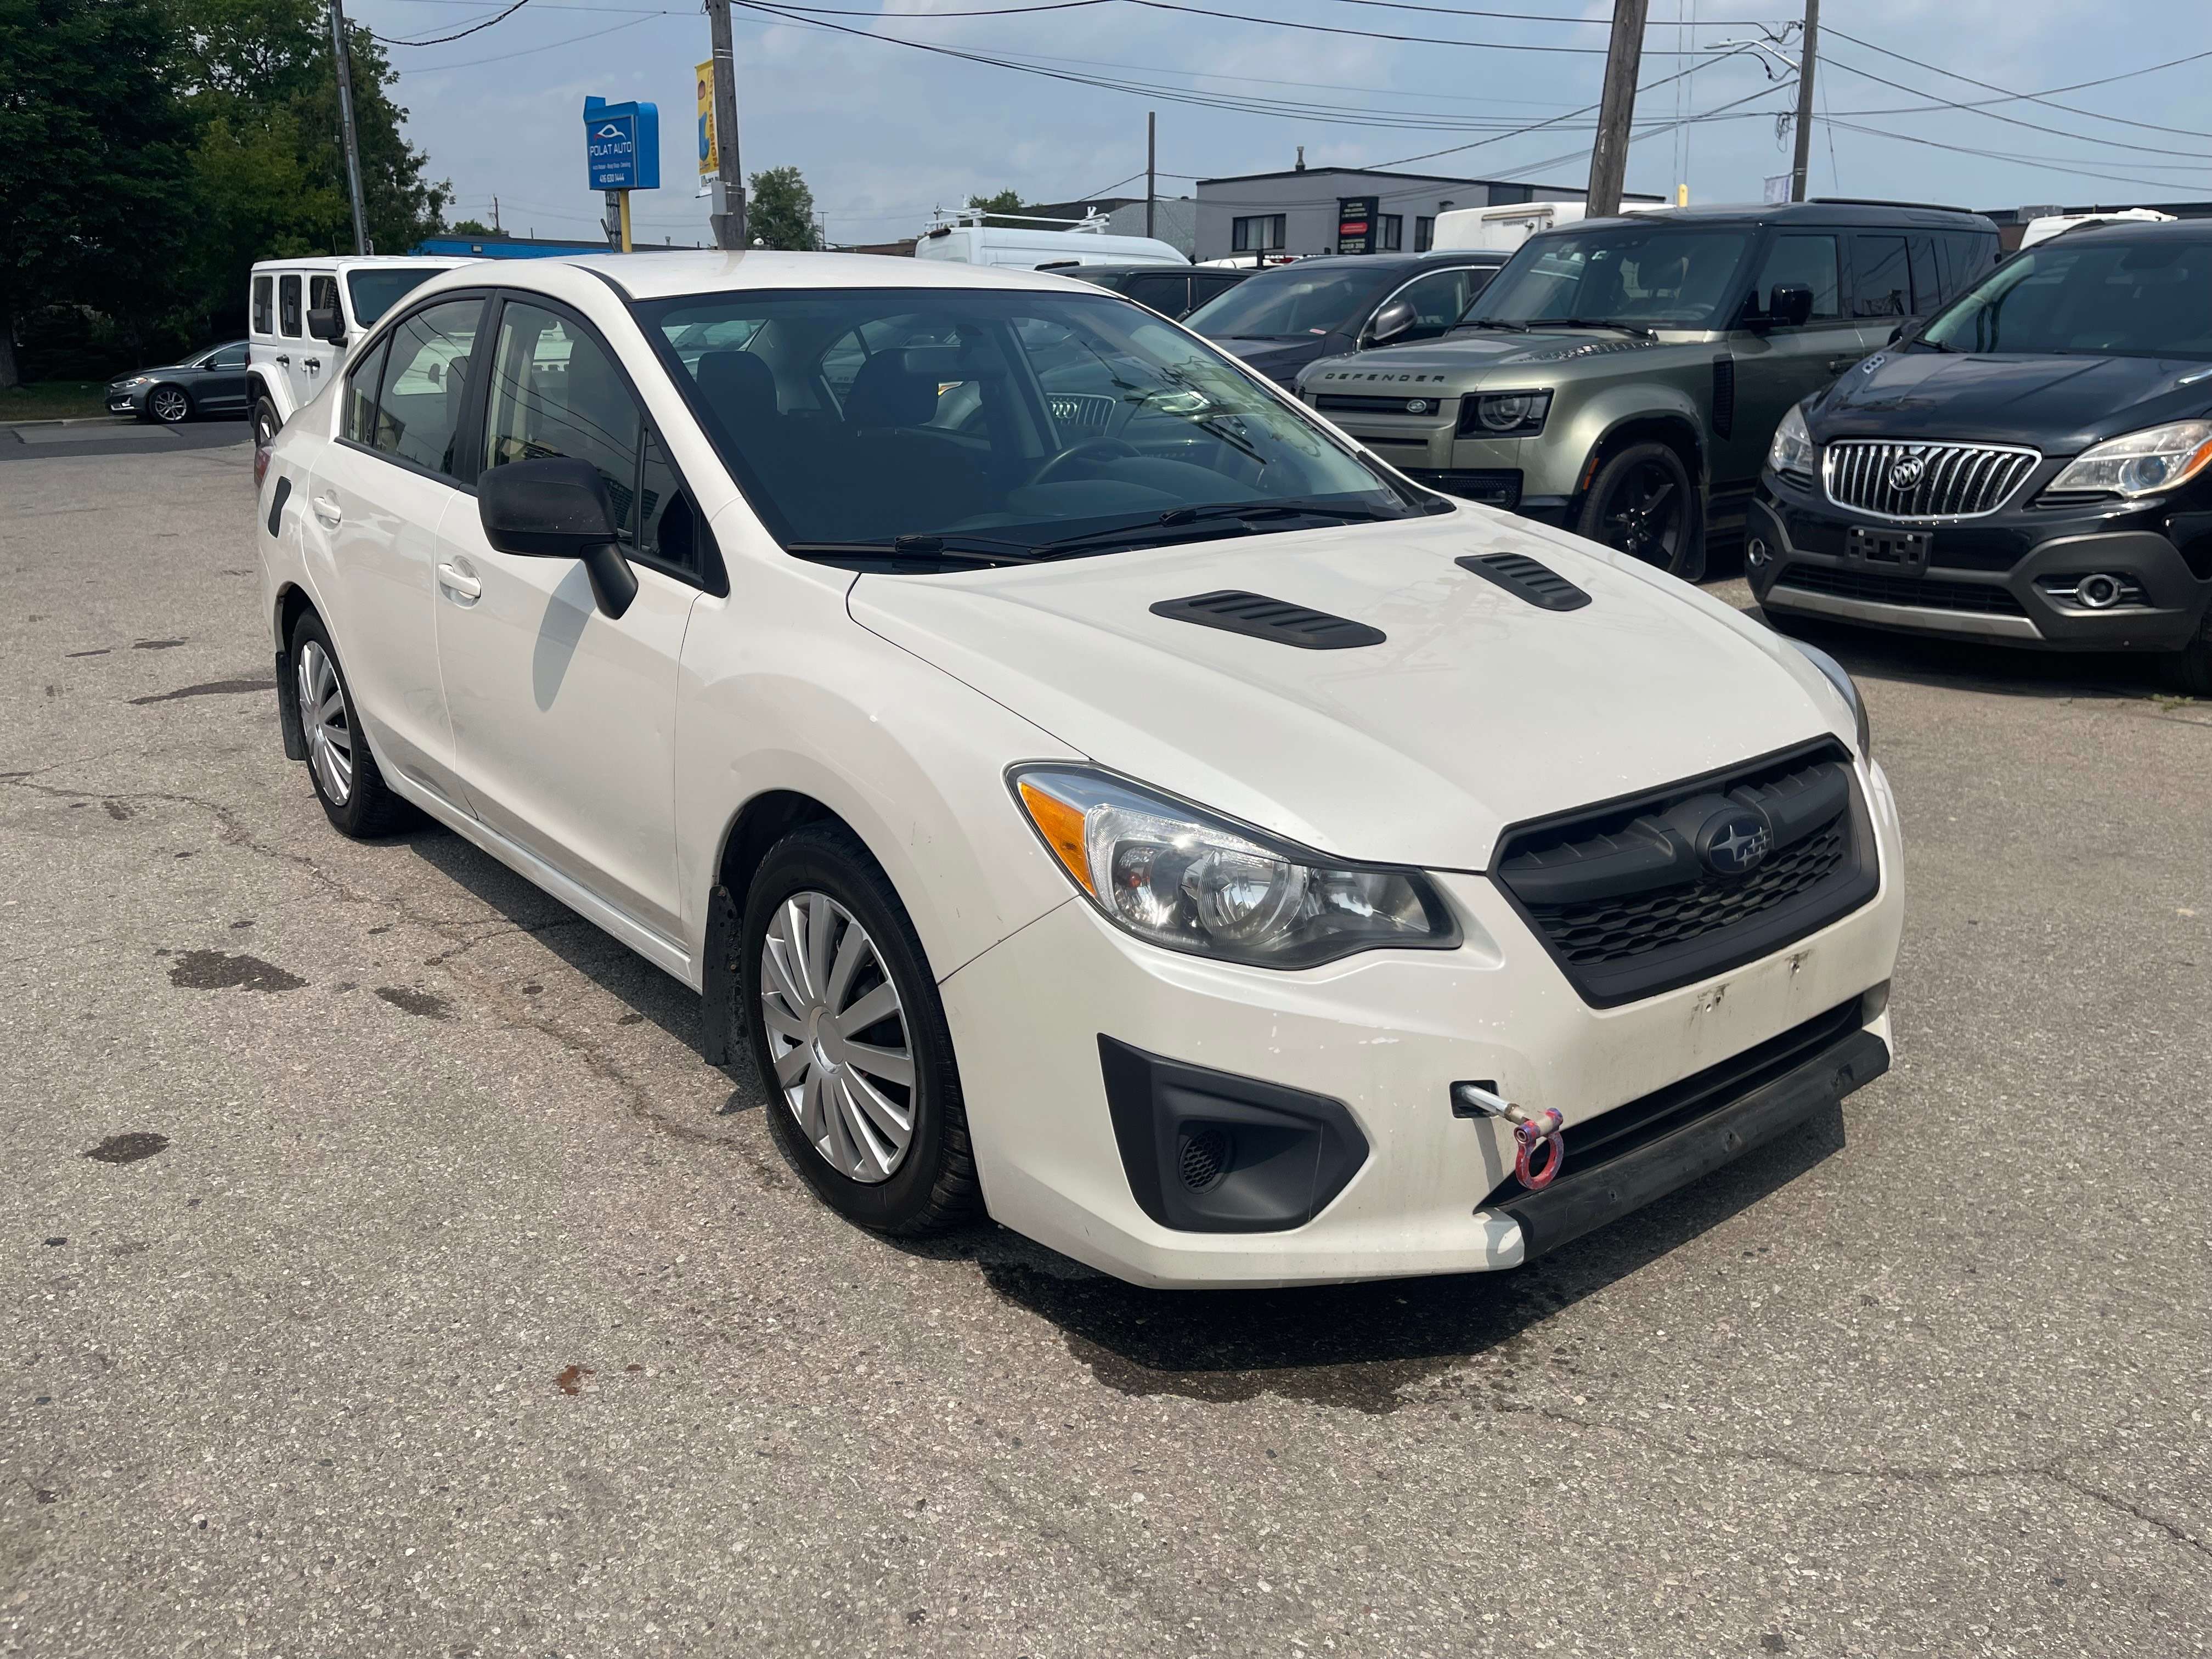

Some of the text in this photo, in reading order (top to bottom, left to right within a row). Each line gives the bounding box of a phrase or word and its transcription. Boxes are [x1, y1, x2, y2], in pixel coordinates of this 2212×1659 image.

[709, 114, 719, 167] DESIGN
[590, 142, 632, 156] POLAT AUTO
[1325, 373, 1444, 382] DEFENDER
